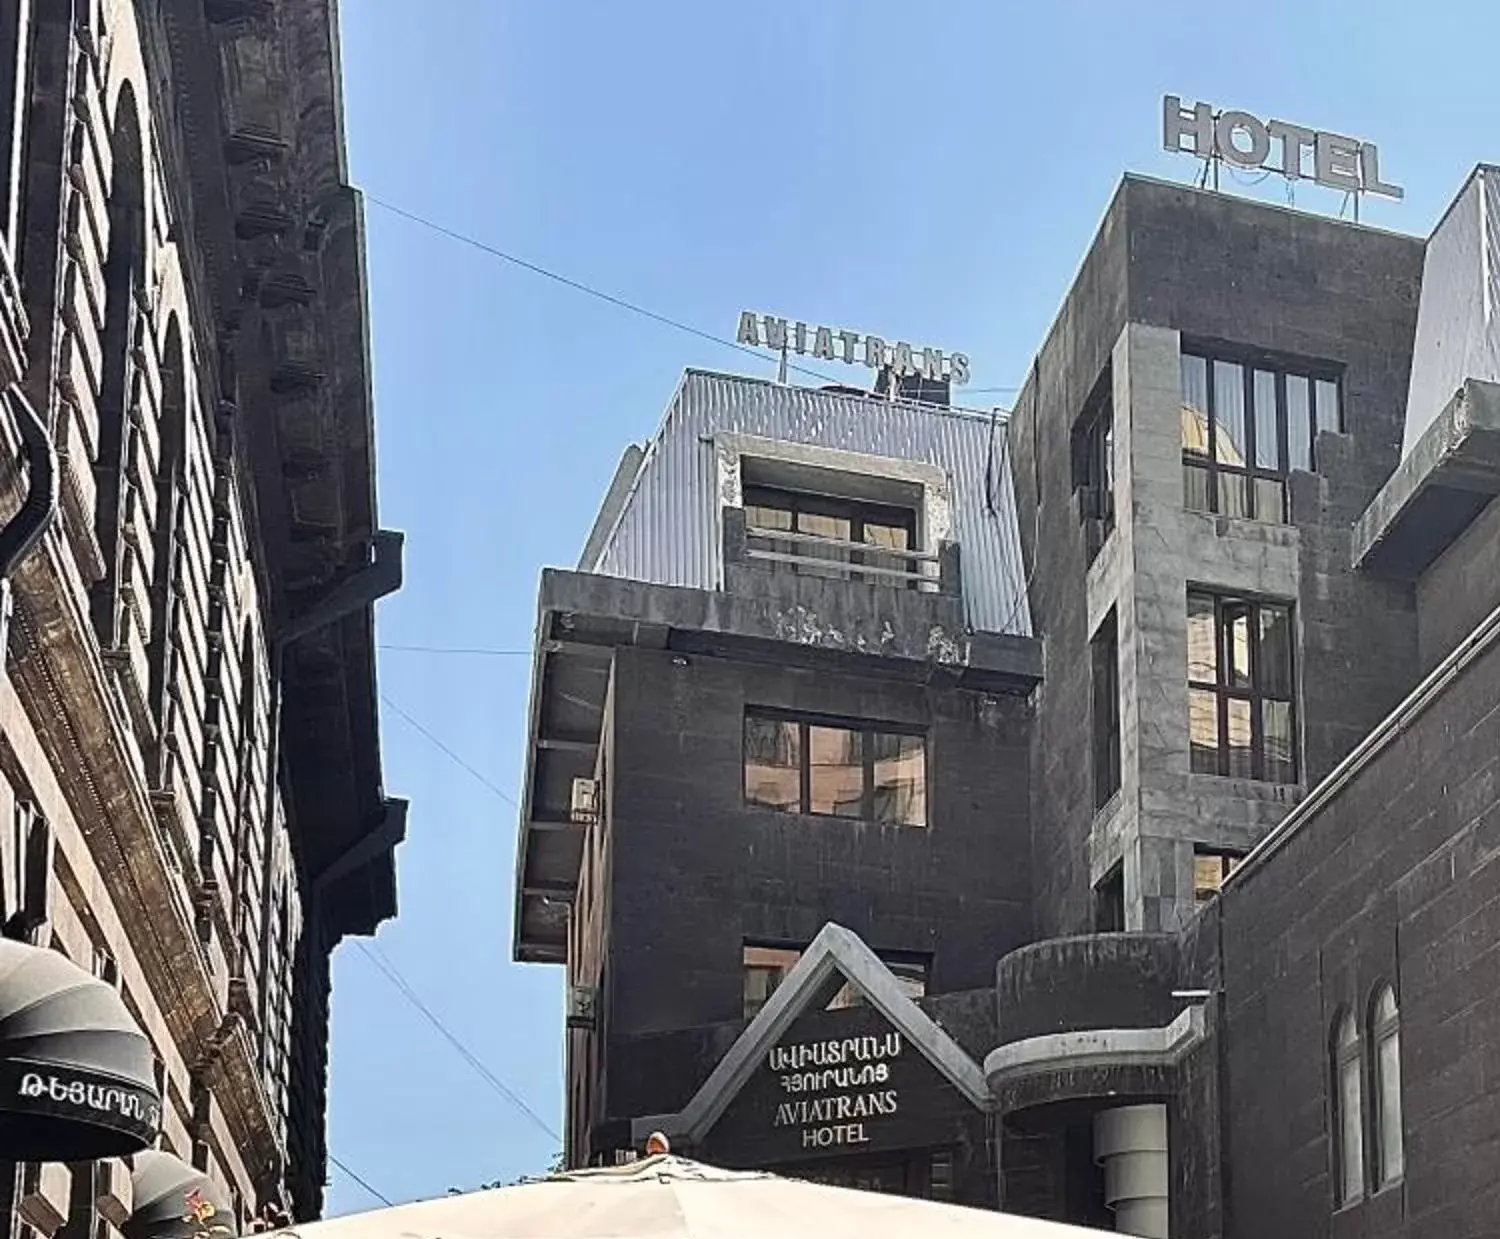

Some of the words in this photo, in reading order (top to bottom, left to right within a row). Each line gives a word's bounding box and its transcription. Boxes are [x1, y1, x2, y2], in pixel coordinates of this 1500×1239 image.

[1164, 94, 1404, 198] HOTEL
[737, 311, 971, 385] AVIATRANS
[769, 1032, 900, 1070] ԱՎԻԱՏՐԱՆՍ
[773, 1090, 898, 1127] AVIATRANS
[802, 1123, 871, 1147] HOTEL
